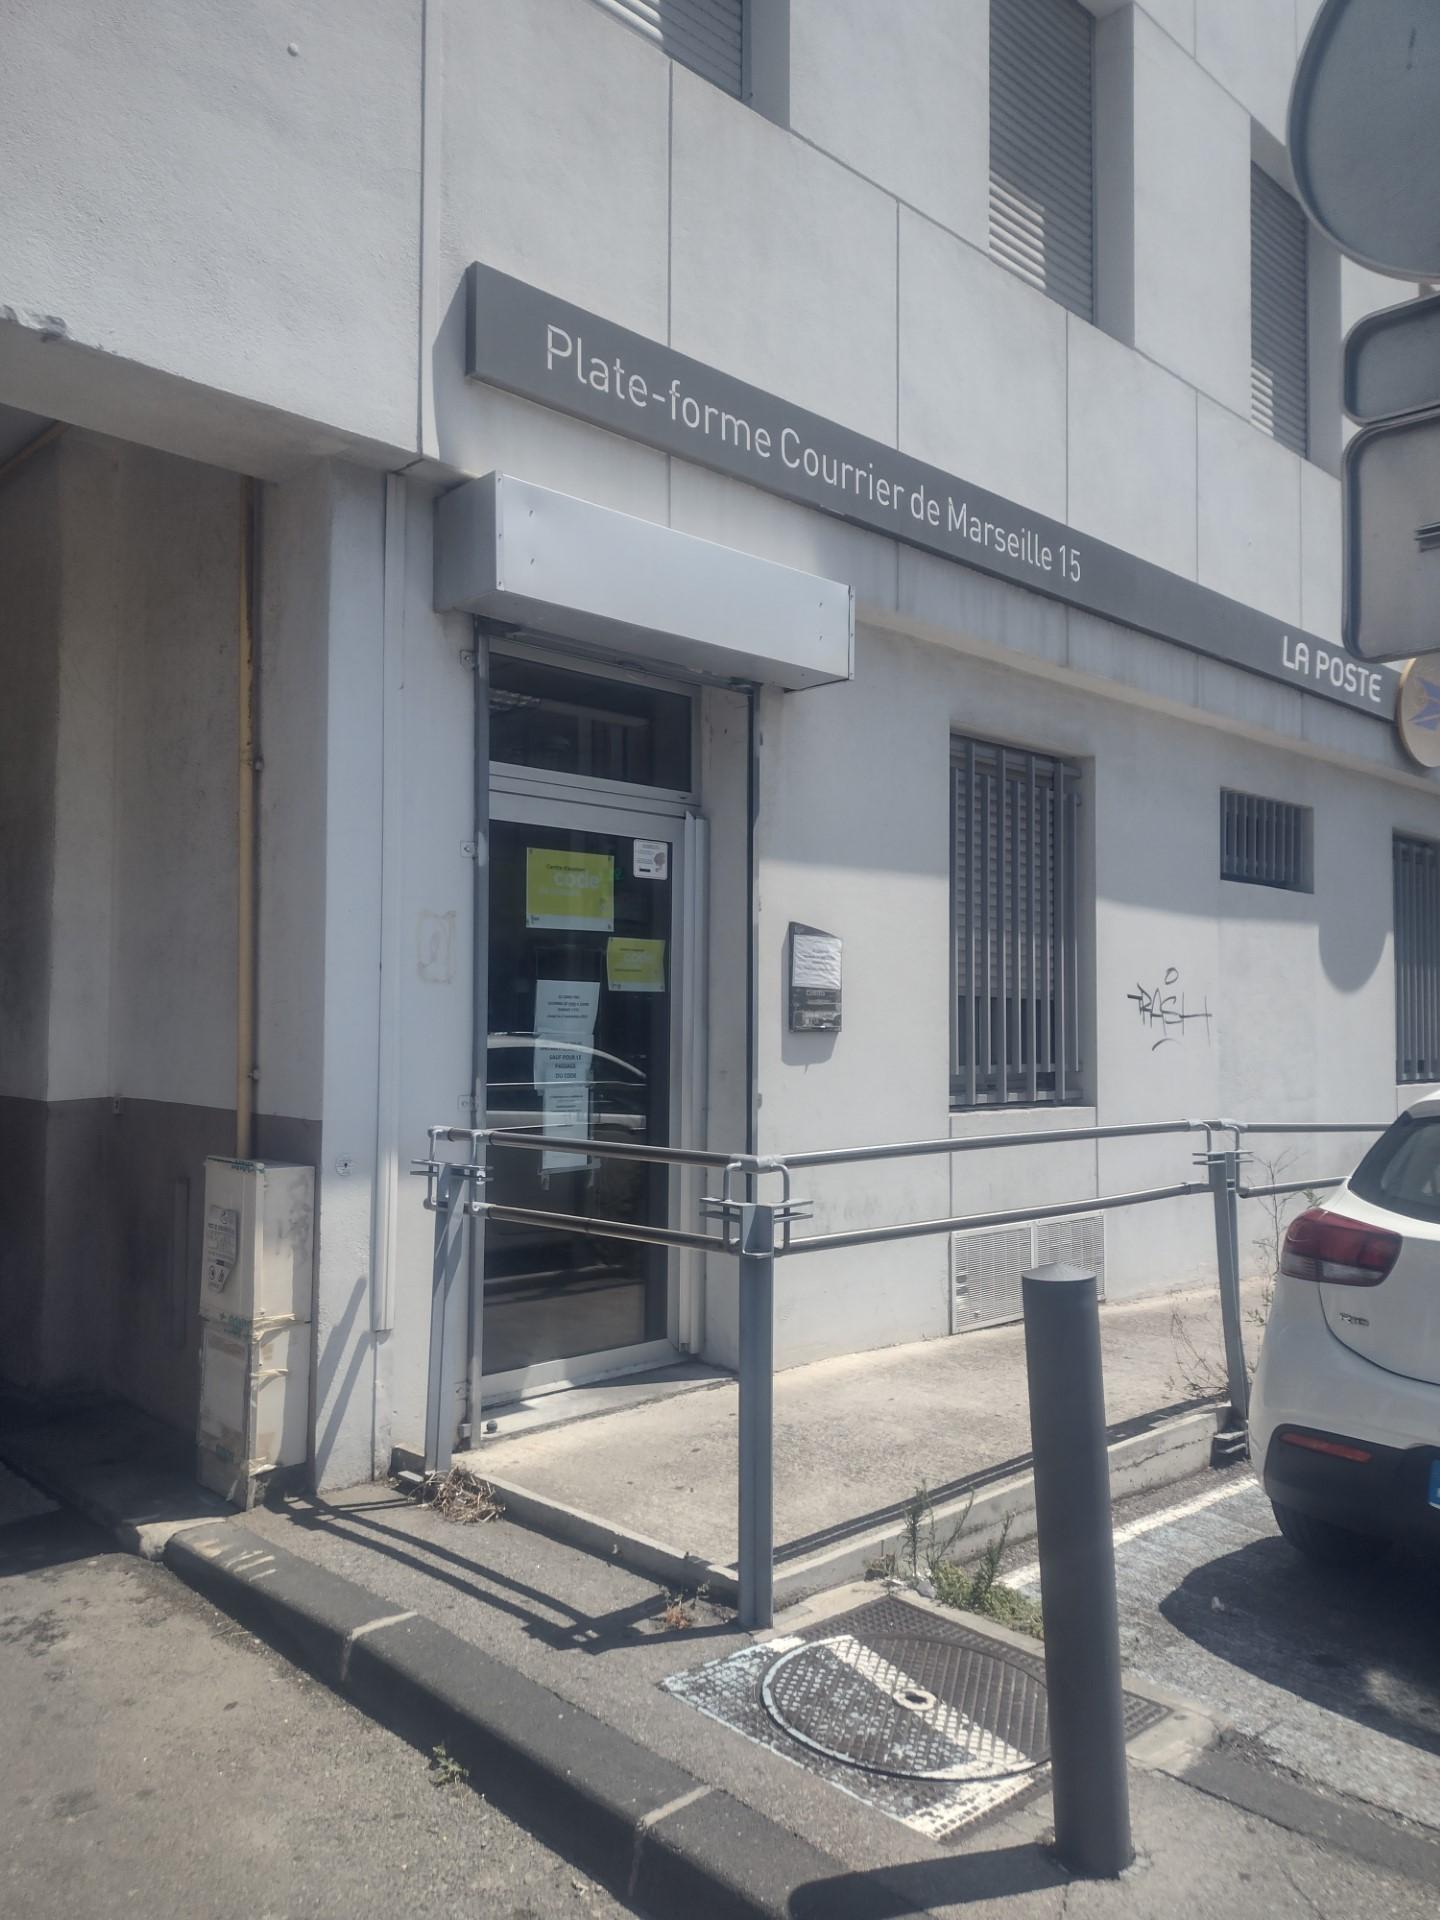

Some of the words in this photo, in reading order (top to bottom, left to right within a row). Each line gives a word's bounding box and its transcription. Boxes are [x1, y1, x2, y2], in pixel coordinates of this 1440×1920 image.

[547, 324, 771, 458] Plate-forme
[781, 428, 905, 510] Courrier
[910, 485, 940, 526] de
[948, 496, 1052, 571] Marseille
[1059, 545, 1081, 582] 15
[1282, 635, 1310, 675] LA
[1315, 650, 1382, 702] POSTE
